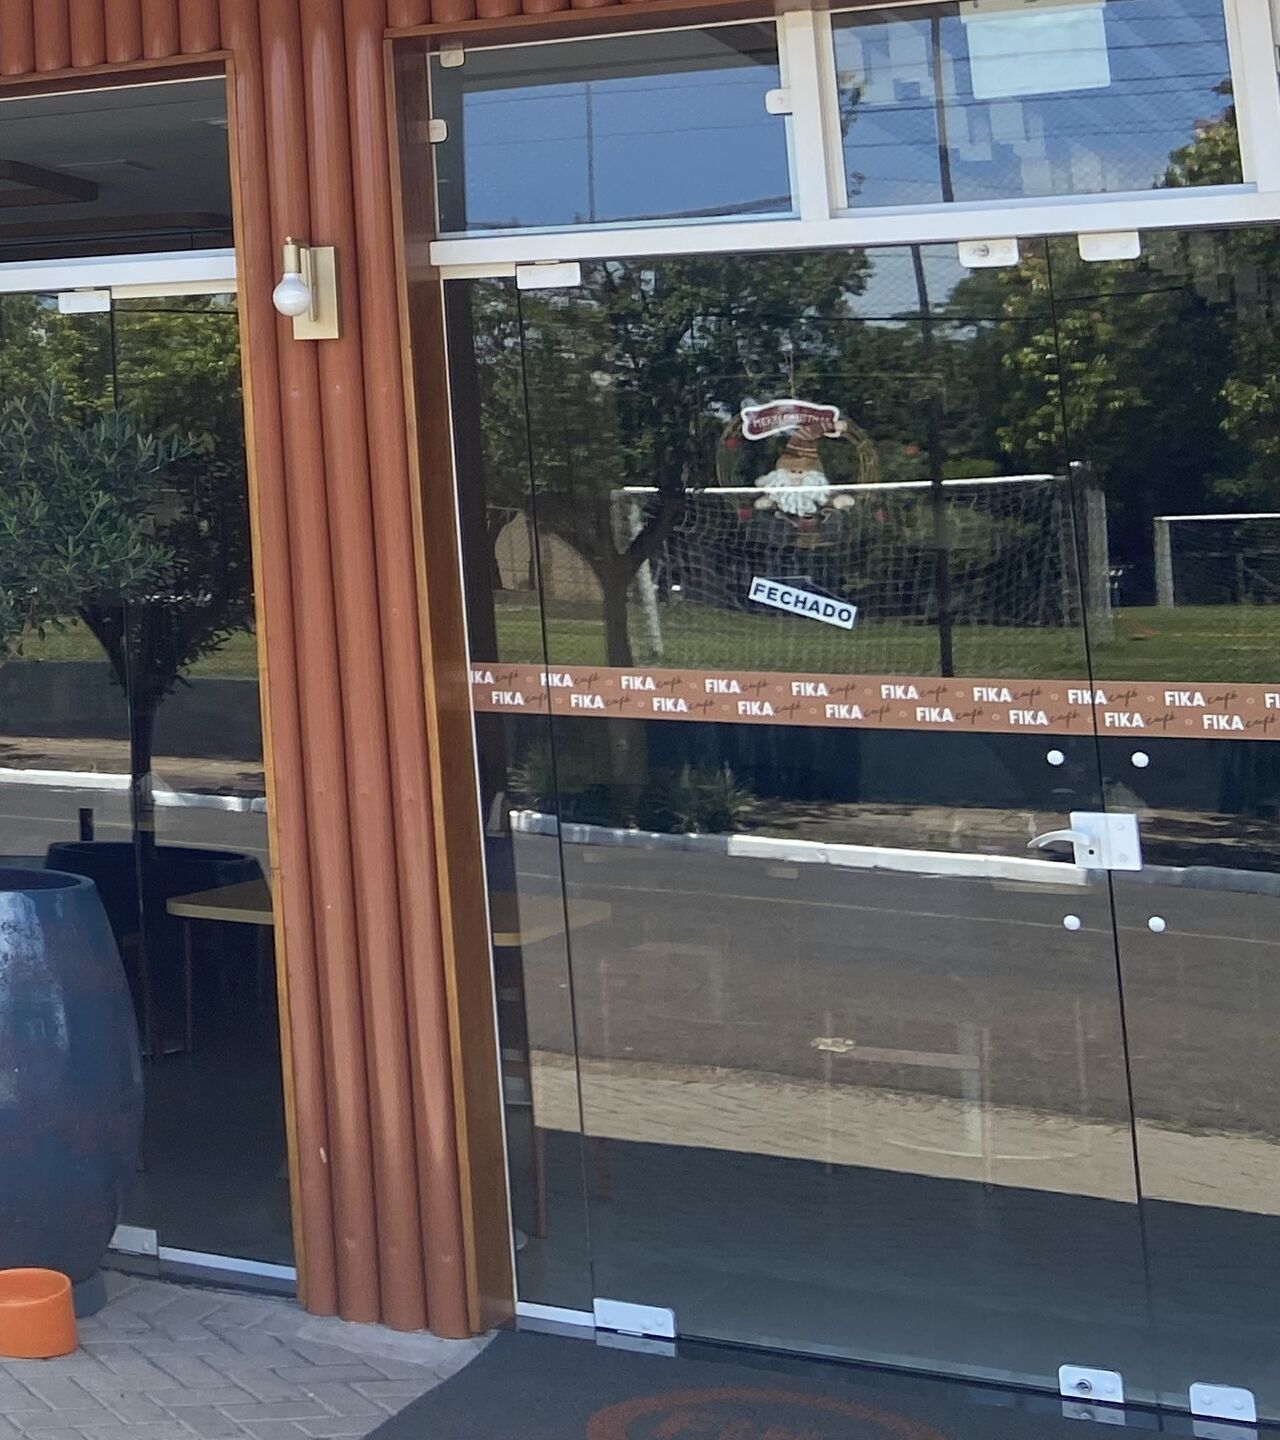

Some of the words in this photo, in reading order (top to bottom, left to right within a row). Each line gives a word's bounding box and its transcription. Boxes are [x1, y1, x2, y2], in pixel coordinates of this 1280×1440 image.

[753, 582, 852, 622] FECHADO
[470, 670, 494, 685] IKA
[541, 672, 574, 688] FIKA
[621, 675, 656, 691] FIKA
[704, 678, 741, 694] FIKA
[791, 681, 828, 697] FIKA
[881, 684, 919, 700] FIKA
[973, 687, 1012, 702] FIKA
[1067, 689, 1107, 705] FIKA
[1164, 691, 1206, 707] FIKA
[1264, 692, 1280, 709] FI
[491, 691, 525, 706] FIKA
[570, 693, 605, 709] FIKA
[652, 697, 689, 713] FIKA
[737, 700, 775, 716] FIKA
[825, 703, 863, 720] FIKA
[916, 707, 955, 723] FIKA
[1009, 709, 1049, 726] FIKA
[1104, 712, 1145, 728] FIKA
[1203, 714, 1245, 731] FIKA
